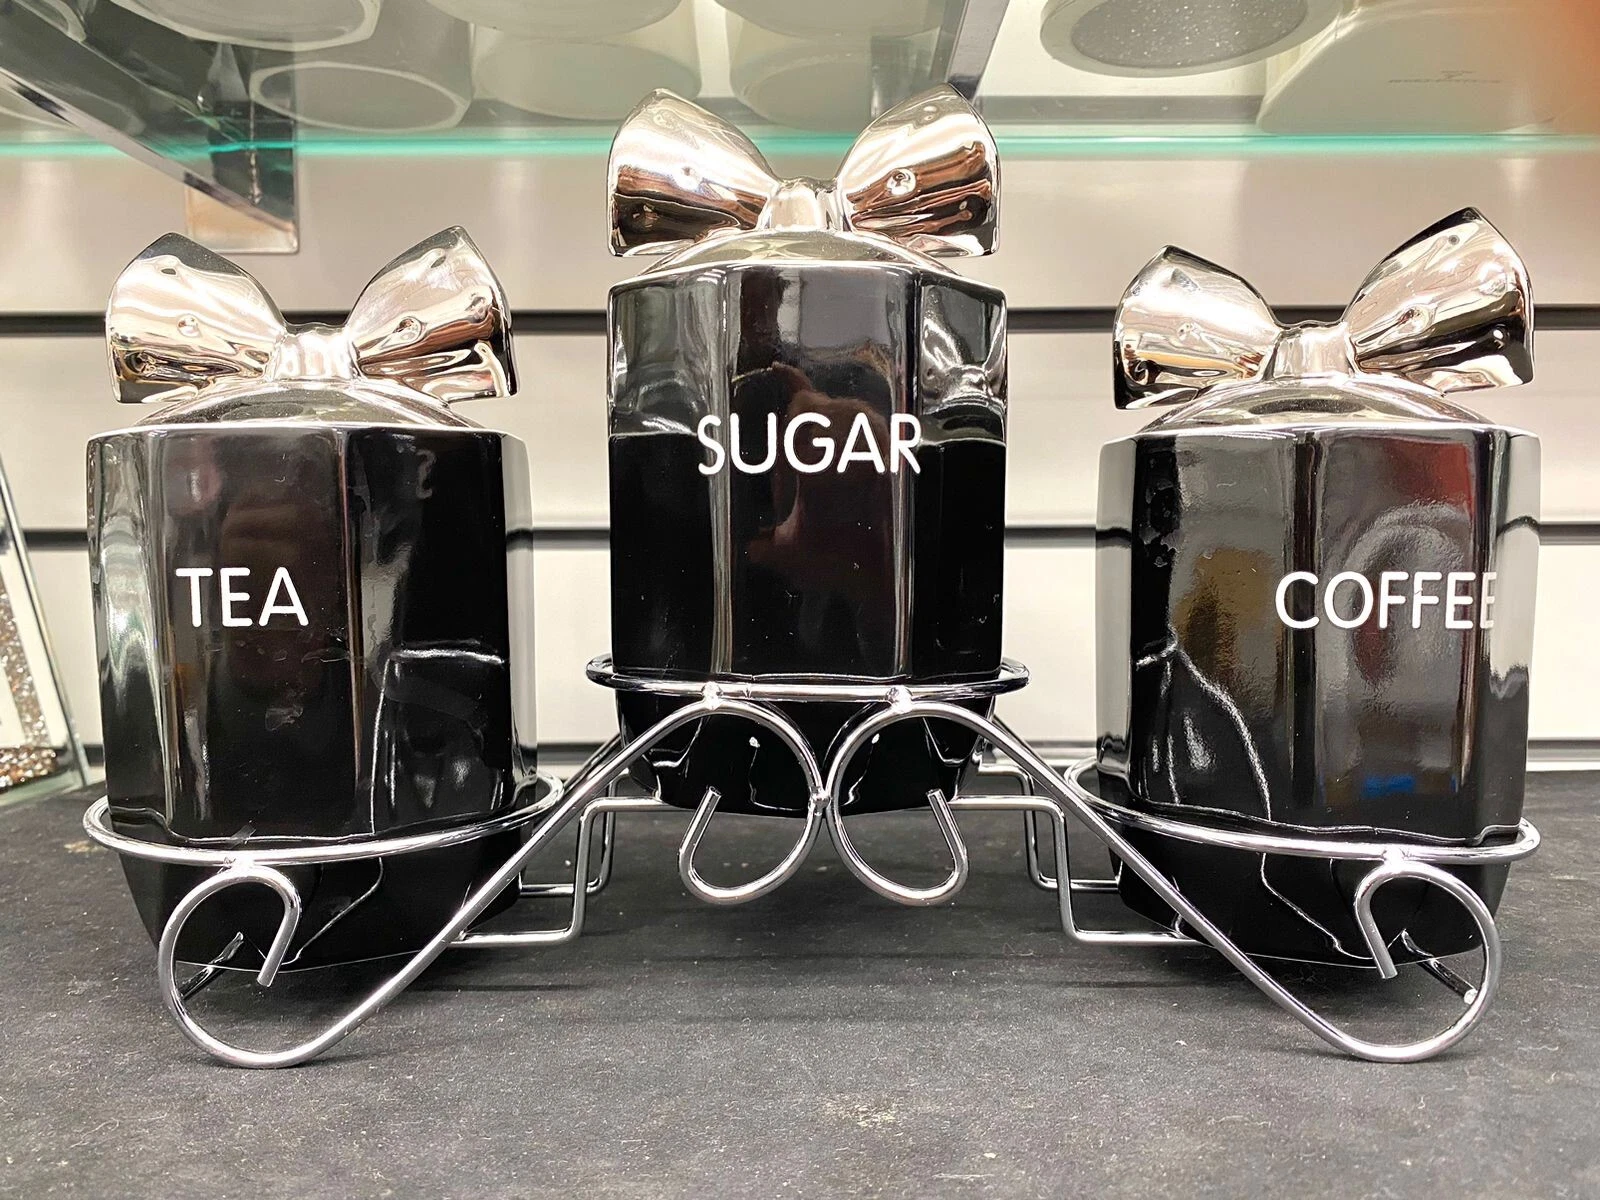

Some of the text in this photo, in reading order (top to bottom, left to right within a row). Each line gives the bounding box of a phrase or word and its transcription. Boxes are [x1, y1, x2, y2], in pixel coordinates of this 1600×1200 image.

[697, 412, 923, 475] SUGAR
[175, 566, 309, 627] TEA
[1275, 571, 1497, 629] COFFEE
